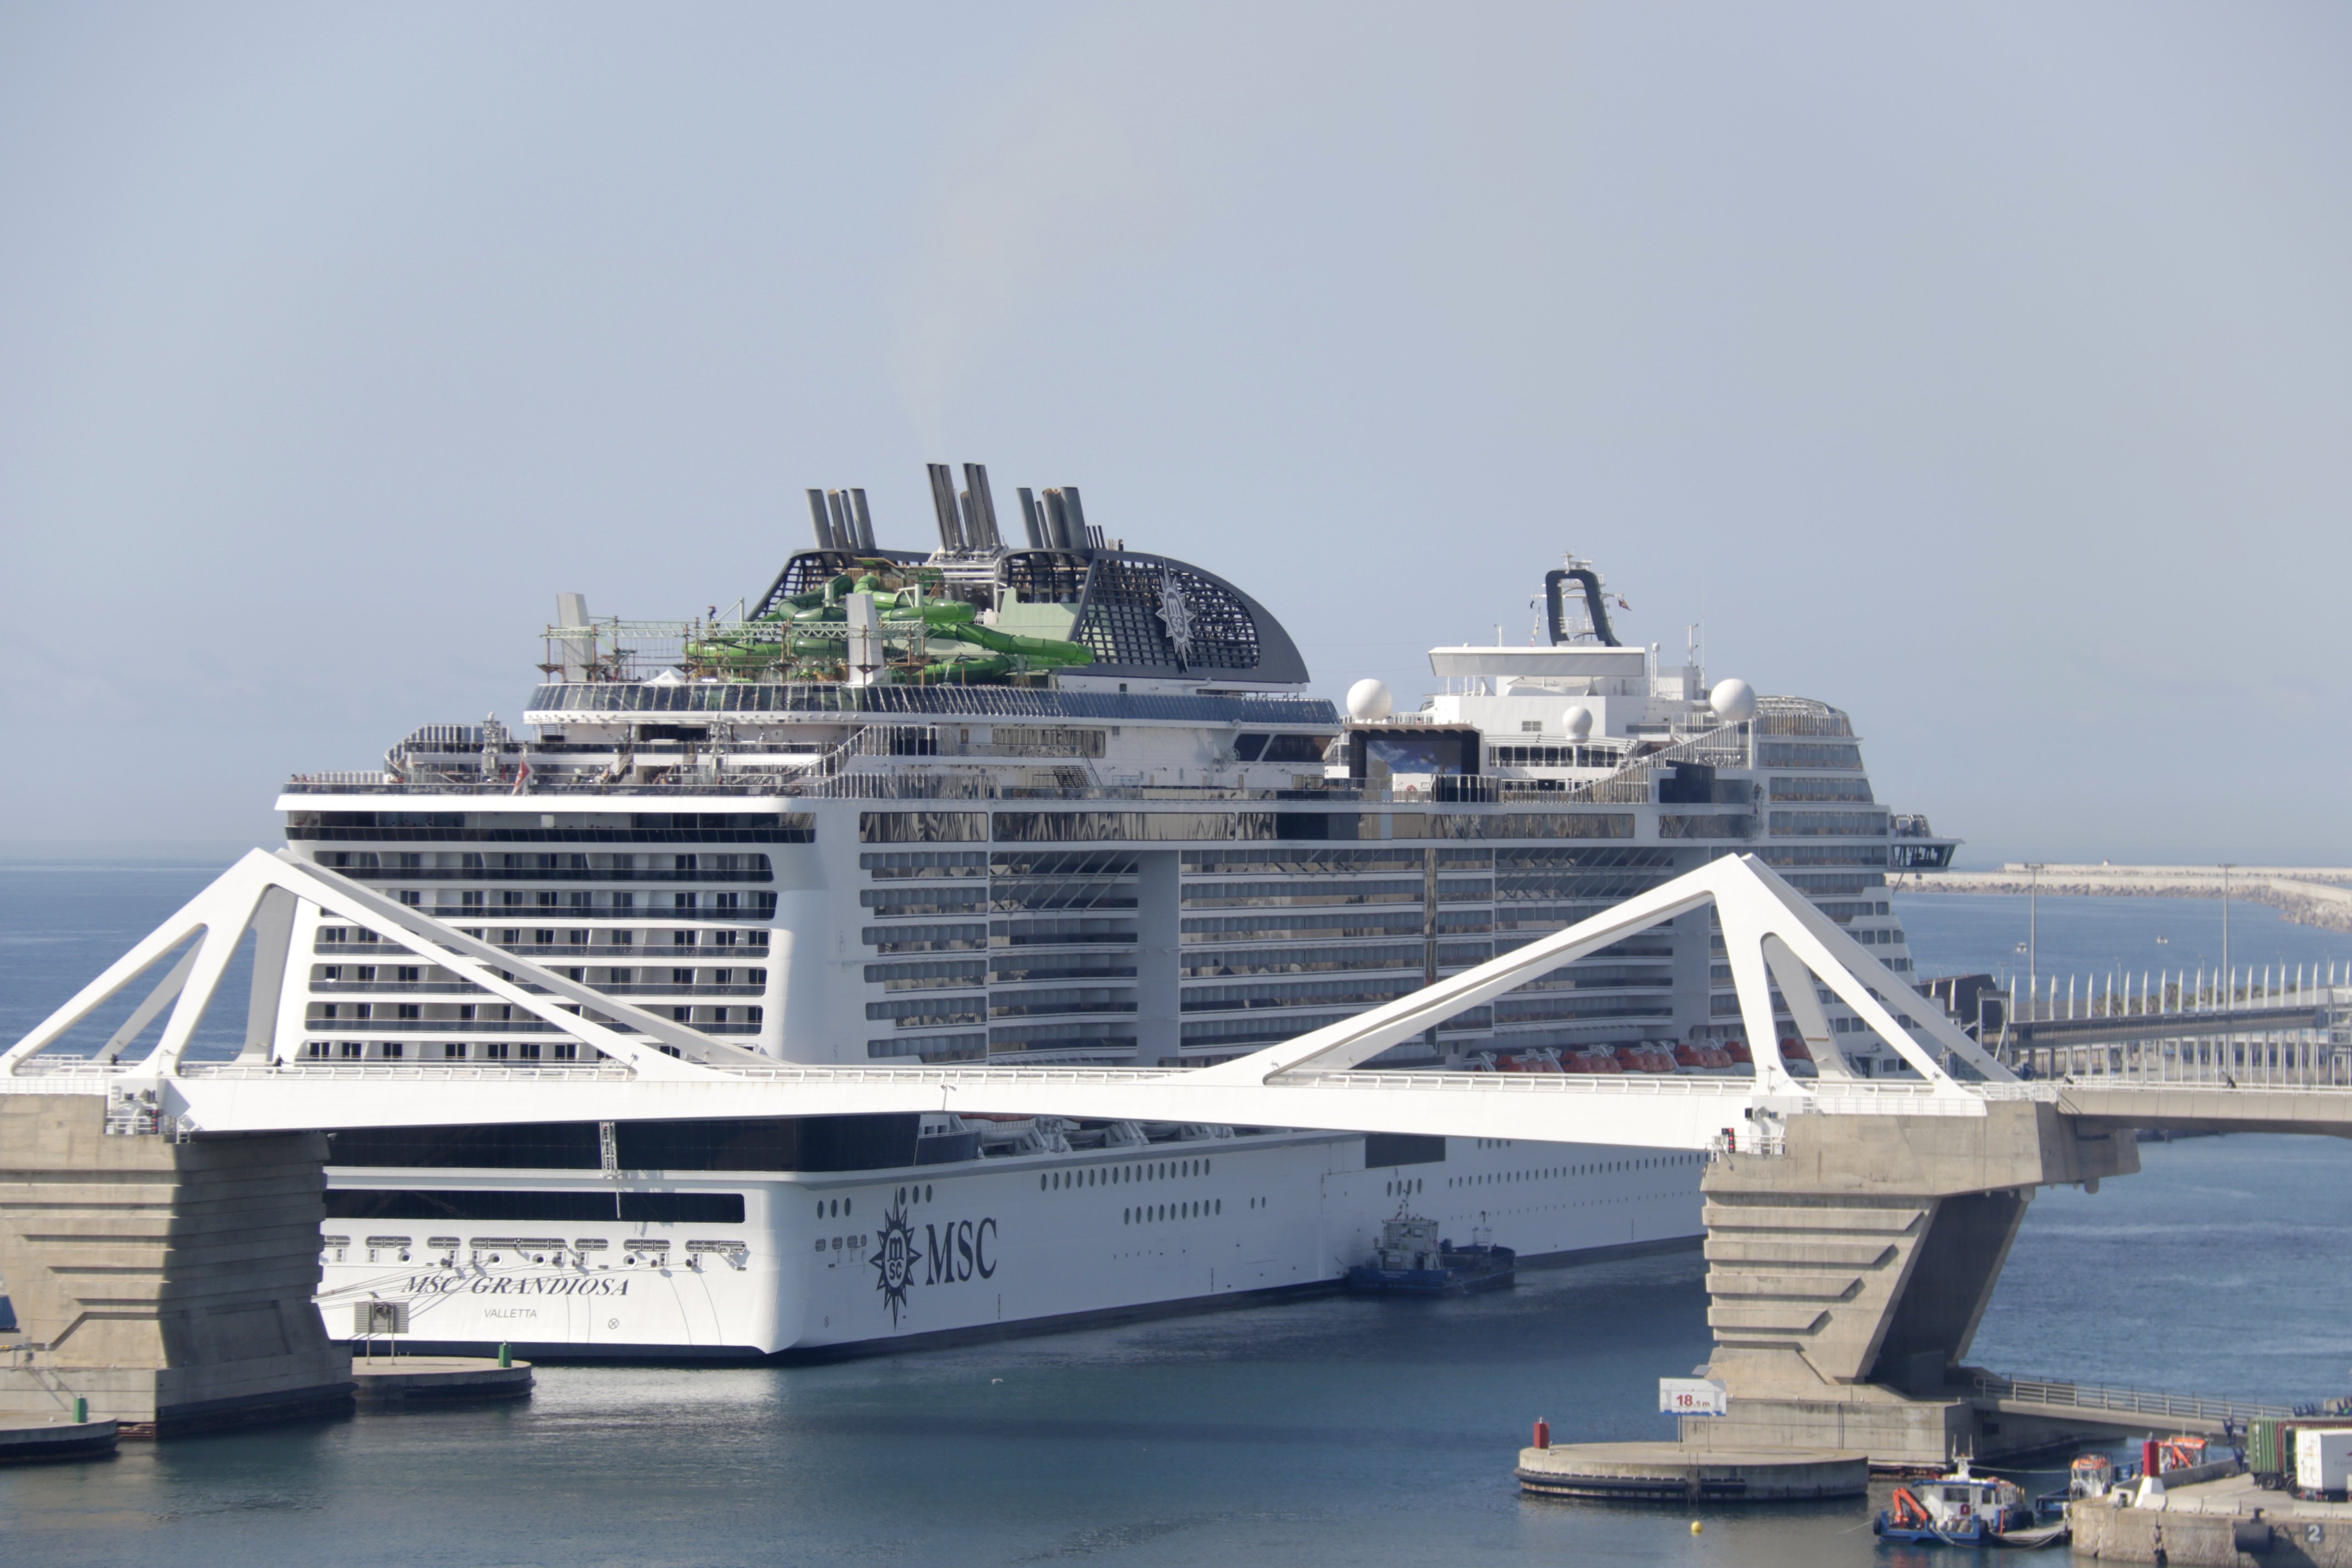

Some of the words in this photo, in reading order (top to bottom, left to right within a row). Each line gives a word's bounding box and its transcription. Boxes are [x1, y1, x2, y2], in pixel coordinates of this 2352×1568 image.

[925, 1217, 998, 1286] MSC
[401, 1276, 462, 1294] MSC
[471, 1276, 629, 1295] GRANDIOSA
[484, 1308, 537, 1318] VALLETTA
[2308, 1525, 2321, 1542] 2
